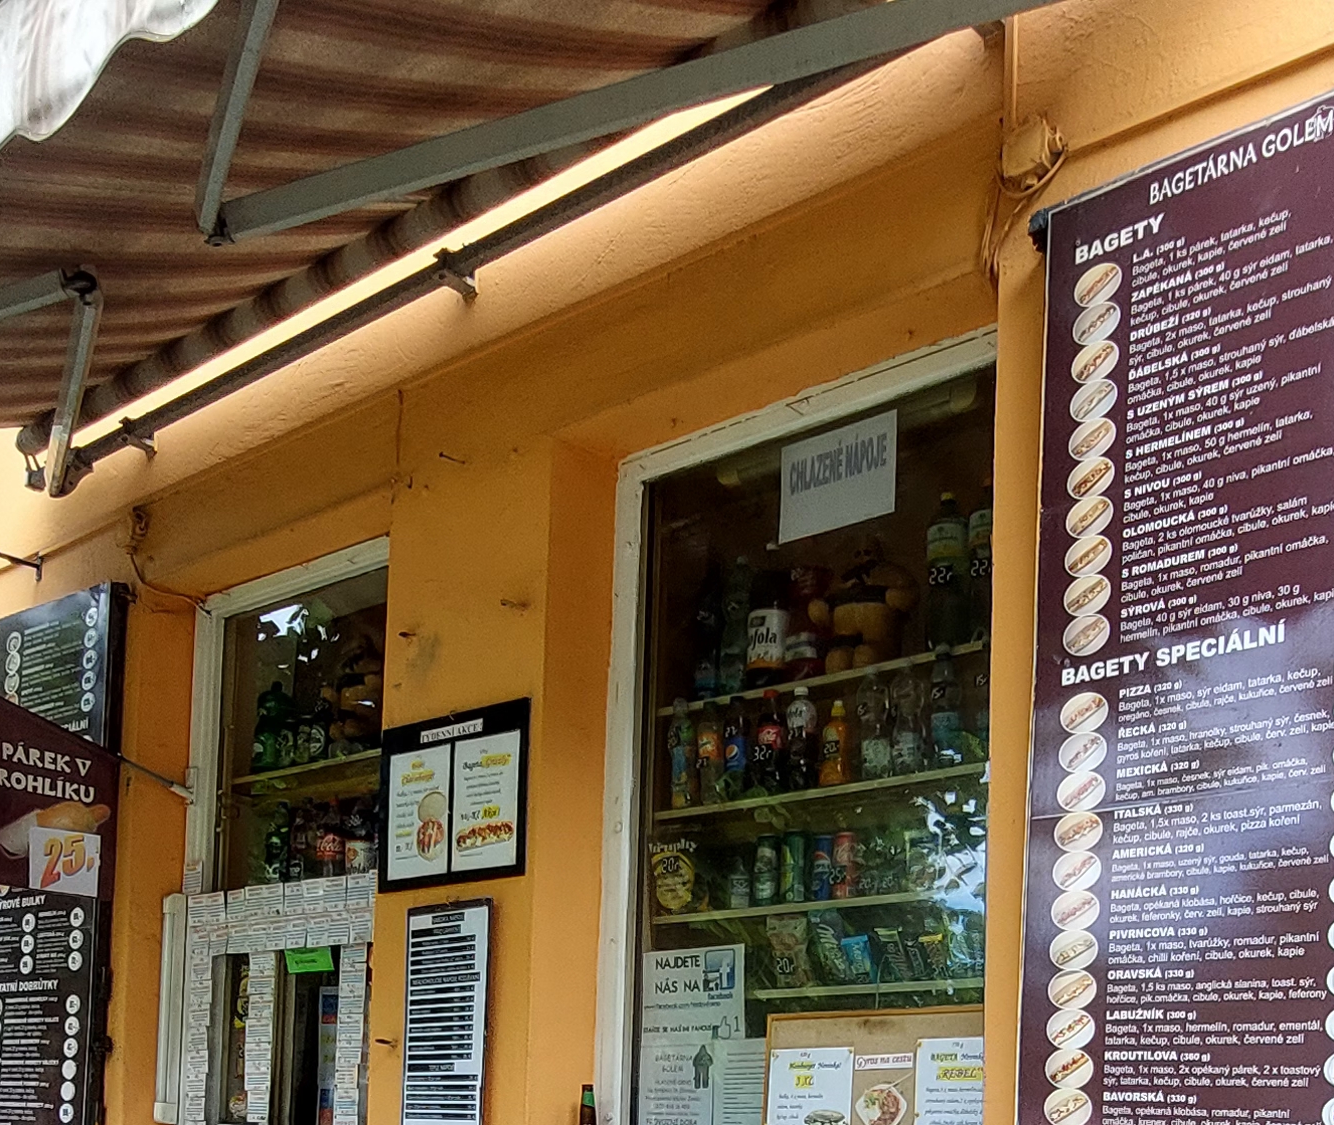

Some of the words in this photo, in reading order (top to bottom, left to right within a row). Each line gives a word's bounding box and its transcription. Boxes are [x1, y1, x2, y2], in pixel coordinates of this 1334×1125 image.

[1149, 141, 1257, 204] BAGETÁRNA
[1262, 110, 1334, 159] GOLEM
[1075, 213, 1165, 265] BAGETY
[1127, 410, 1134, 420] S
[1137, 393, 1185, 417] UZENÝM
[1188, 382, 1229, 405] SÝREM
[1125, 449, 1133, 459] S
[1136, 424, 1211, 457] HERMELÍNEM
[789, 441, 843, 496] CHLAZENÉ
[845, 432, 887, 478] NÁPOJE
[1124, 489, 1131, 498] S
[1135, 478, 1170, 496] NIVOU
[1122, 509, 1195, 538] OLOMOUCKÁ
[1121, 568, 1129, 578] S
[1131, 549, 1205, 577] ROMADUREM
[1120, 596, 1165, 618] SÝROVÁ
[1061, 653, 1149, 686] BAGETY
[1156, 618, 1286, 667] SPECIÁLNÍ
[1119, 684, 1151, 698] PIZZA
[1, 741, 71, 773] PÁREK
[75, 760, 91, 776] V
[1116, 759, 1167, 778] MEXICKÁ
[1114, 802, 1161, 820] ITALSKÁ
[1112, 840, 1172, 859] AMERICKÁ
[1109, 927, 1175, 940] PIVRNCOVA
[655, 955, 700, 970] NAJDETE
[1108, 966, 1161, 980] ORAVSKÁ
[655, 977, 678, 994] NÁS
[684, 980, 700, 993] NA
[892, 1054, 912, 1063] cestu
[1104, 1050, 1178, 1062] KROUTILOVA
[1103, 1089, 1164, 1103] BAVORSKÁ
